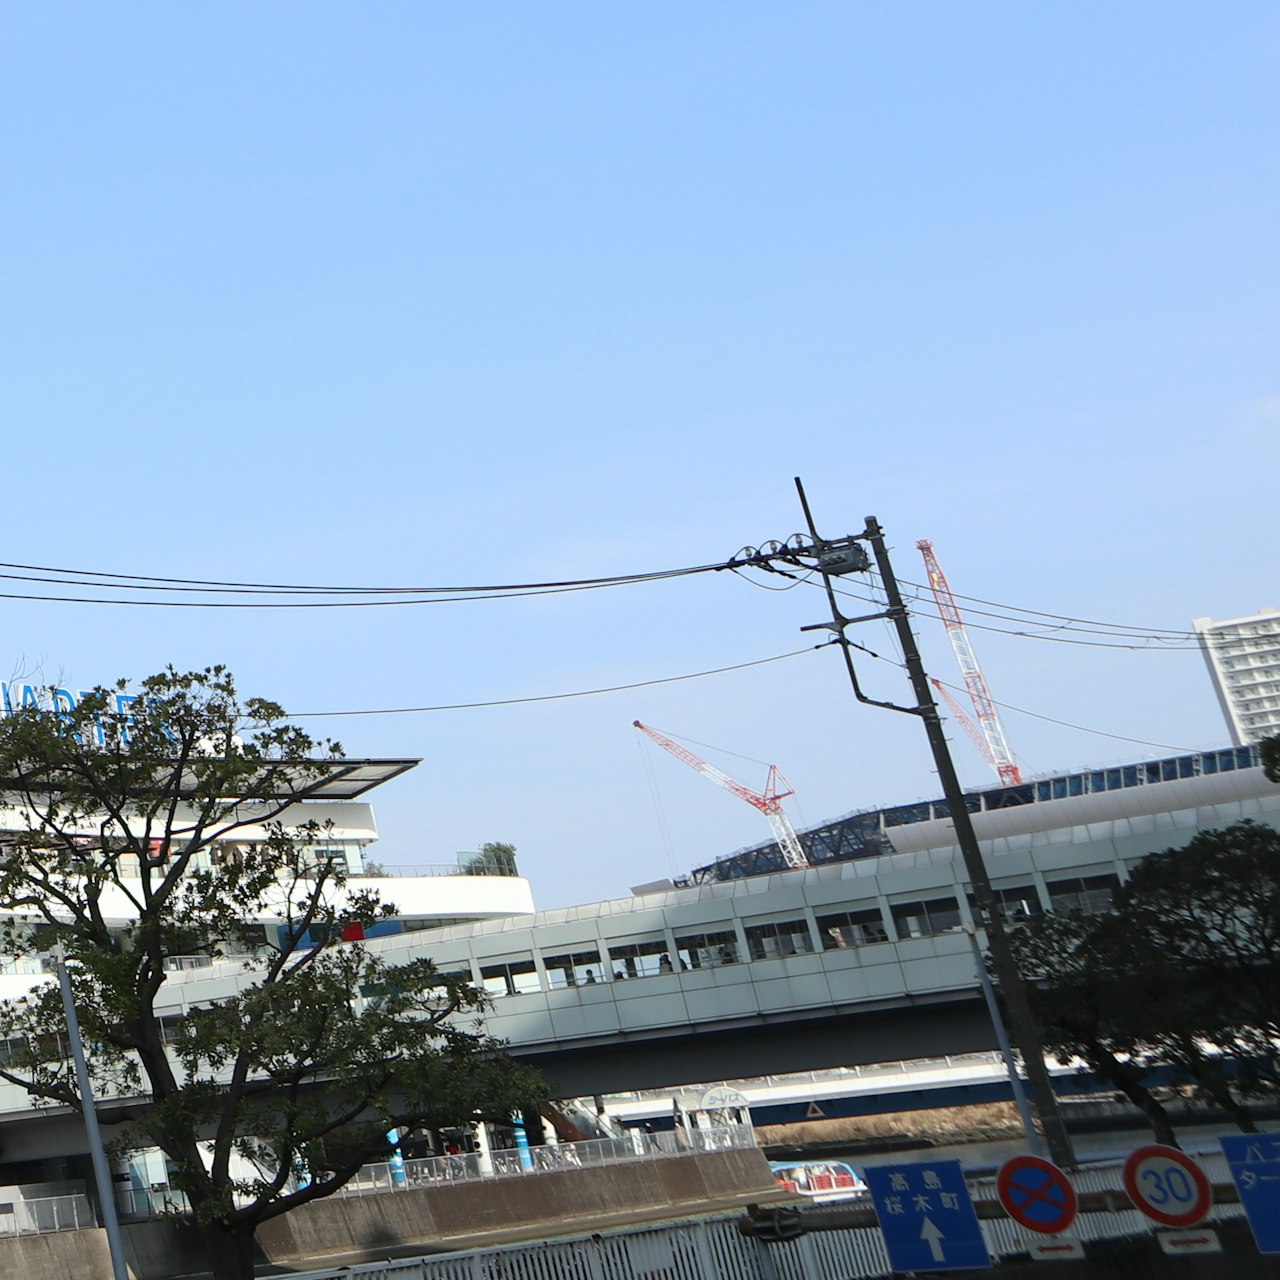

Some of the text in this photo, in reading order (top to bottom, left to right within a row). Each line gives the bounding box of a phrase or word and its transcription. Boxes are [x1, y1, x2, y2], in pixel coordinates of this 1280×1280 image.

[888, 1169, 943, 1192] 高島
[1142, 1166, 1192, 1205] 30
[883, 1191, 960, 1215] 桜木町
